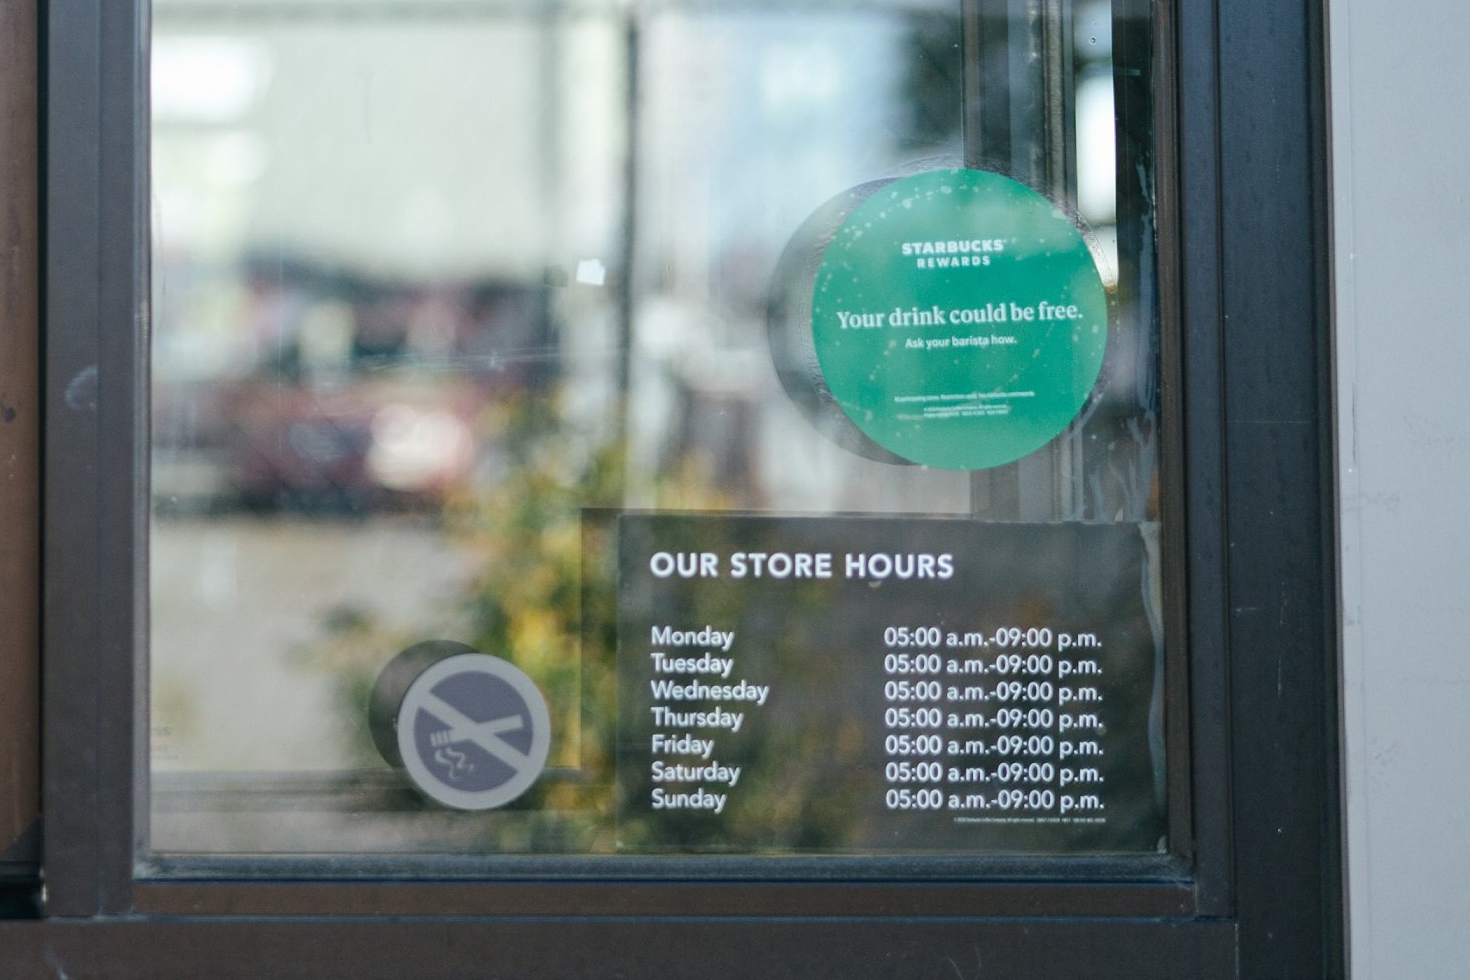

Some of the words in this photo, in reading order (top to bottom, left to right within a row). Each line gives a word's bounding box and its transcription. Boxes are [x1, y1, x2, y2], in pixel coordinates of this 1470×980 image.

[901, 239, 1004, 255] STARBUCKS
[916, 256, 990, 269] REWARDS
[837, 311, 885, 329] Your
[889, 305, 946, 326] drink
[949, 303, 1006, 323] could
[1010, 302, 1034, 321] be
[1039, 301, 1083, 320] free.
[905, 337, 924, 348] Ask
[926, 338, 950, 350] your
[951, 335, 989, 347] barista
[990, 334, 1018, 345] how.
[650, 552, 718, 577] OUR
[731, 552, 832, 578] STORE
[846, 552, 955, 579] HOURS
[651, 625, 735, 650] Monday
[883, 627, 942, 647] 05:00
[945, 627, 1053, 647] a.m.-09:00
[1057, 634, 1102, 651] p.m.
[650, 652, 734, 677] Tuesday
[883, 654, 942, 674] 05:00
[946, 654, 1053, 673] a.m.-09:00
[1058, 661, 1102, 678] p.m.
[650, 680, 770, 704] Wednesday
[884, 681, 943, 701] 05:00
[946, 682, 1054, 700] a.m.-09:00
[1058, 688, 1103, 705] p.m.
[650, 706, 744, 731] Thursday
[884, 708, 943, 728] 05:00
[946, 709, 1054, 727] a.m.-09:00
[1058, 714, 1104, 732] p.m.
[651, 734, 715, 758] Friday
[884, 735, 943, 755] 05:00
[947, 736, 1054, 754] a.m.-09:00
[1059, 742, 1104, 759] p.m.
[651, 761, 741, 786] Saturday
[885, 762, 944, 782] 05:00
[947, 763, 1054, 781] a.m.-09:00
[1059, 769, 1104, 786] p.m.
[651, 788, 727, 813] Sunday
[885, 789, 944, 809] 05:00
[947, 790, 1055, 809] a.m.-09:00
[1060, 796, 1105, 813] p.m.
